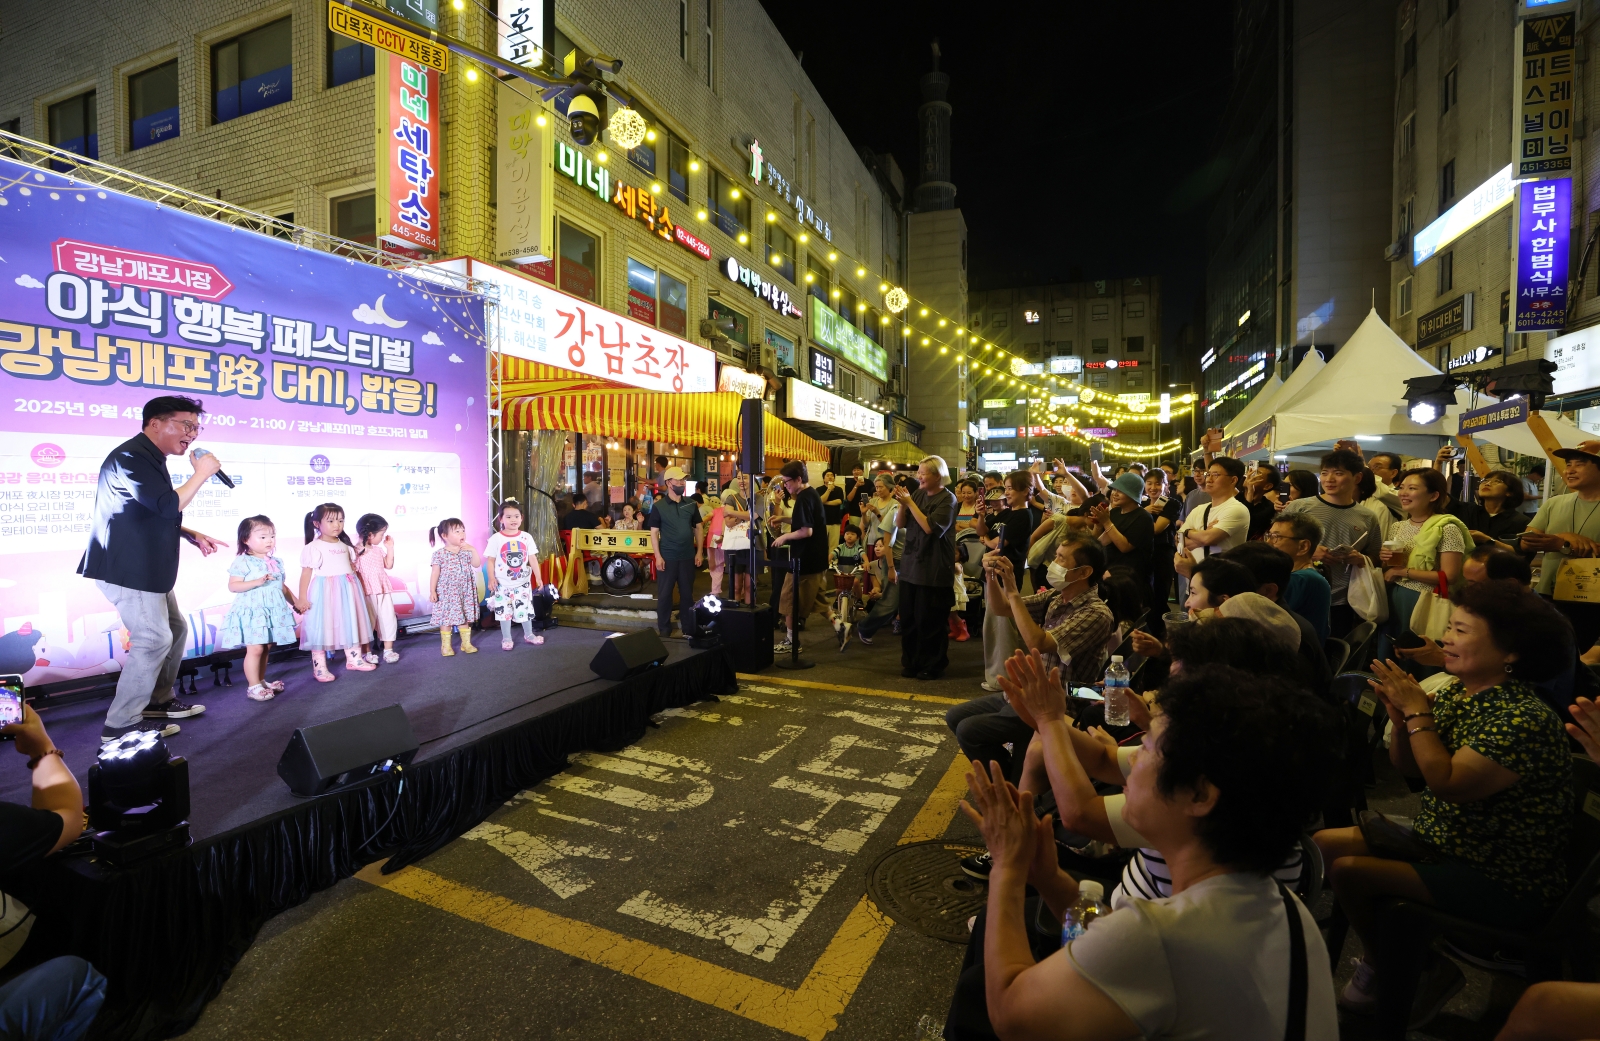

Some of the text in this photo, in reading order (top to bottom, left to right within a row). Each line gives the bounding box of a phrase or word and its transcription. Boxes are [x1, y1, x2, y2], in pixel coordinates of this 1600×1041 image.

[336, 12, 373, 37] 다목적
[377, 28, 406, 52] CCTV
[409, 40, 442, 67] 작동중
[1524, 58, 1546, 134] 퍼스널
[1548, 54, 1572, 156] 트레이닝
[1526, 140, 1542, 156] B1
[1521, 158, 1571, 172] 451-3355
[394, 119, 434, 232] 세탁소
[559, 142, 674, 242] 미네 세탁소
[392, 223, 437, 248] 445-2554
[676, 228, 710, 258] 02-445-2554
[1529, 184, 1556, 286] 법무사 한범식
[73, 250, 212, 290] 강남개포시장
[1522, 285, 1564, 298] 사무소
[1518, 310, 1564, 319] 445-4245
[1518, 318, 1564, 326] 6011-4246~8
[47, 273, 411, 373] 야식 행복 페스티벌
[514, 330, 548, 352] 해산물
[554, 306, 690, 393] 강남초장
[0, 322, 262, 396] 강남개포路
[361, 373, 435, 415] 밝음!
[14, 398, 84, 416] 2025년
[89, 404, 118, 419] 9월
[122, 406, 144, 421] 4일
[250, 418, 286, 430] 21:00
[298, 420, 364, 436] 강남개포시장
[367, 424, 407, 439] 호프거리
[409, 428, 428, 440] 일대
[404, 466, 436, 474] 서울특별시
[708, 458, 716, 472] 남
[26, 472, 56, 484] 음식
[287, 476, 306, 486] 감동
[307, 476, 325, 486] 음악
[26, 490, 60, 500] 夜시장
[64, 490, 96, 499] 맛거리
[709, 482, 717, 492] 초
[0, 502, 75, 512] 야식 요리 대결
[216, 508, 240, 516] 이벤트
[39, 513, 72, 522] 셰프의
[1, 525, 48, 536] 원테이블
